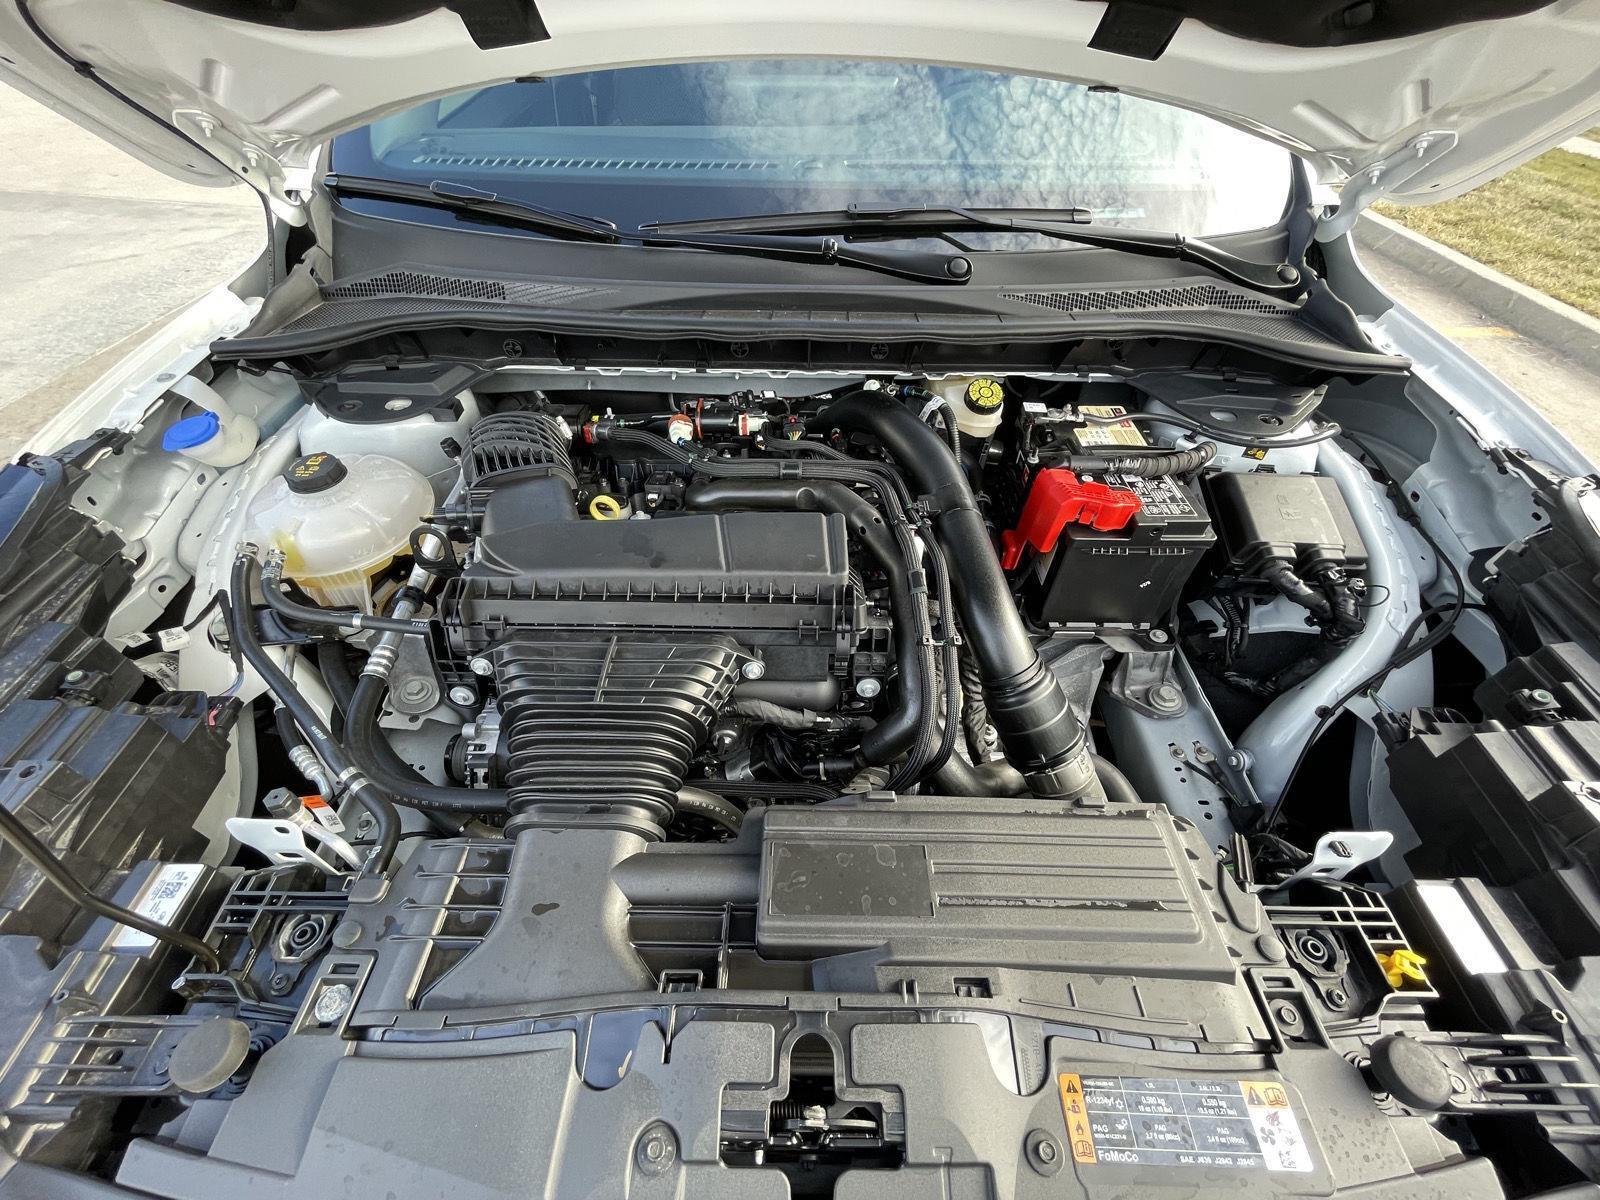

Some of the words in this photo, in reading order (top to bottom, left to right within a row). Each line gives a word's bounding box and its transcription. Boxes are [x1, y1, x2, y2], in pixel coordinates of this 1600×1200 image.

[1156, 1096, 1166, 1106] kg
[1092, 1124, 1108, 1132] PAG
[1098, 1150, 1139, 1162] FoMoCo
[1180, 1156, 1195, 1164] SAE
